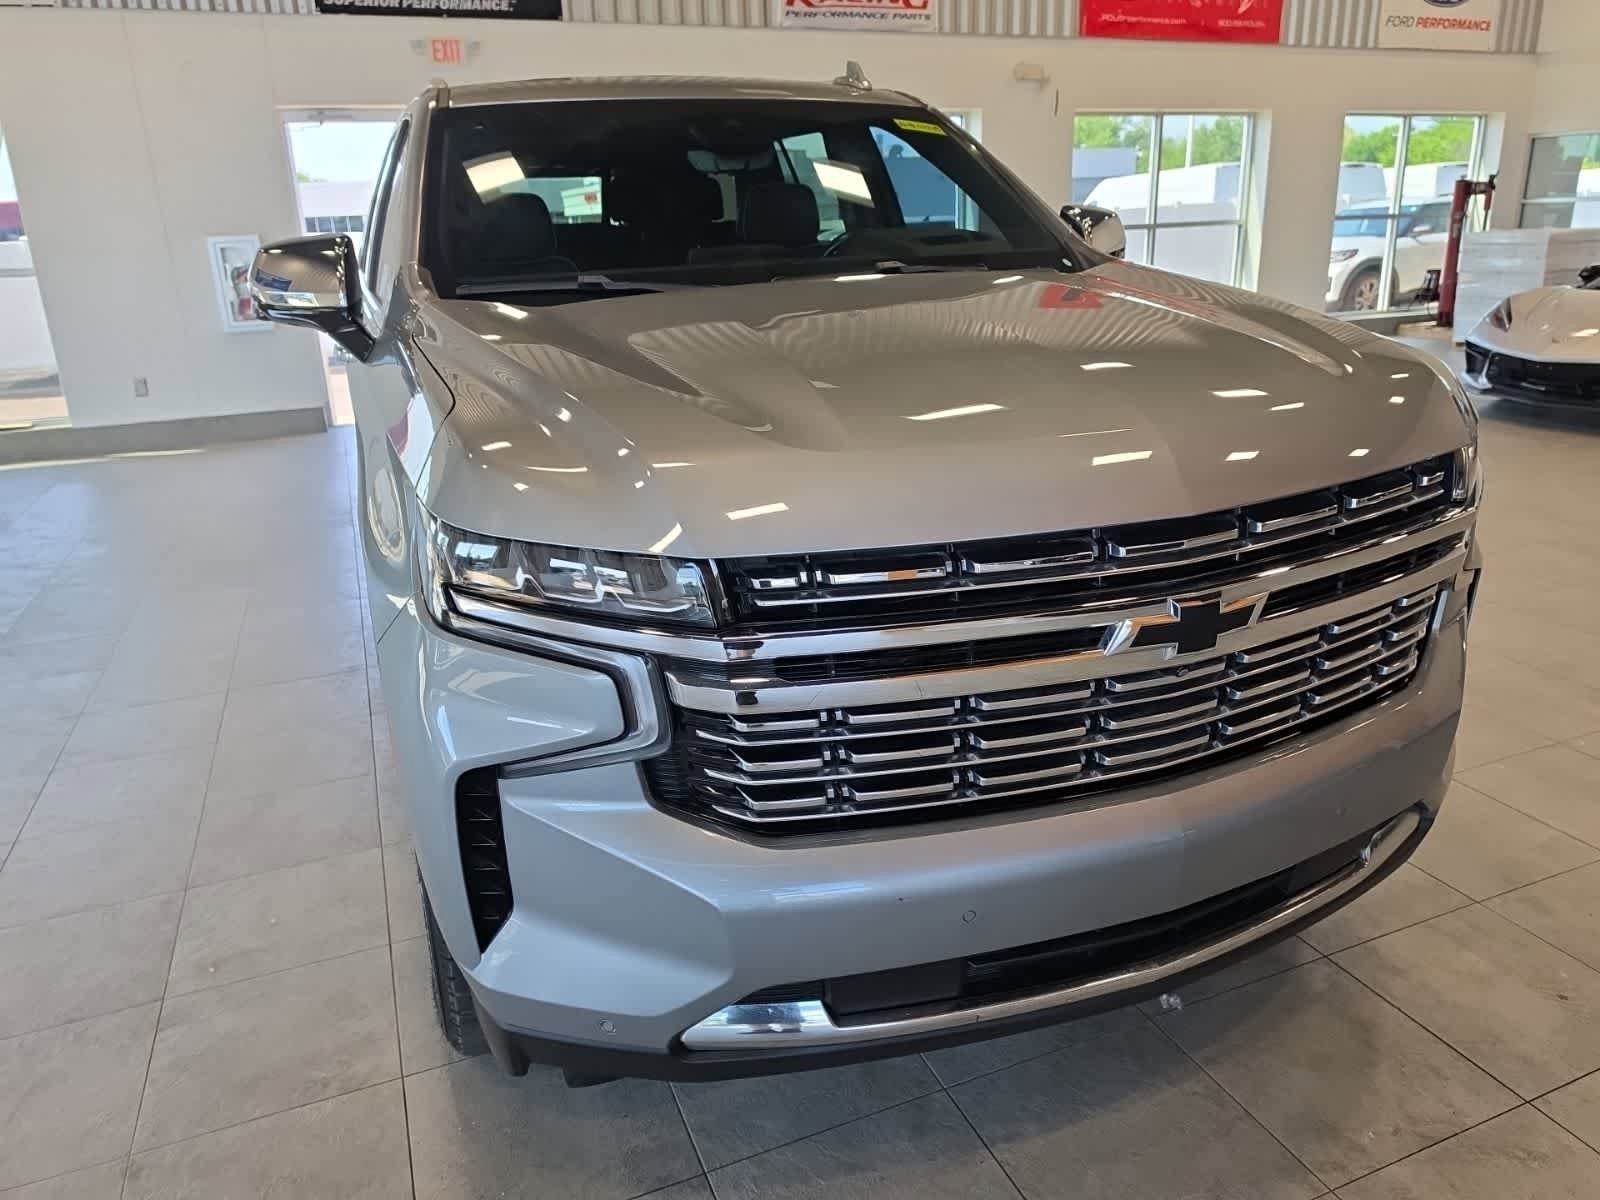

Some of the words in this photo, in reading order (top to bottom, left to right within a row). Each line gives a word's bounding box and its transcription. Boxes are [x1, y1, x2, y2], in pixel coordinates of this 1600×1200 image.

[785, 10, 888, 19] PERFORMANCE
[892, 12, 931, 20] PARTS
[1385, 15, 1415, 28] FORD
[1416, 16, 1491, 31] PERFORMANCE
[431, 39, 460, 64] EXIT
